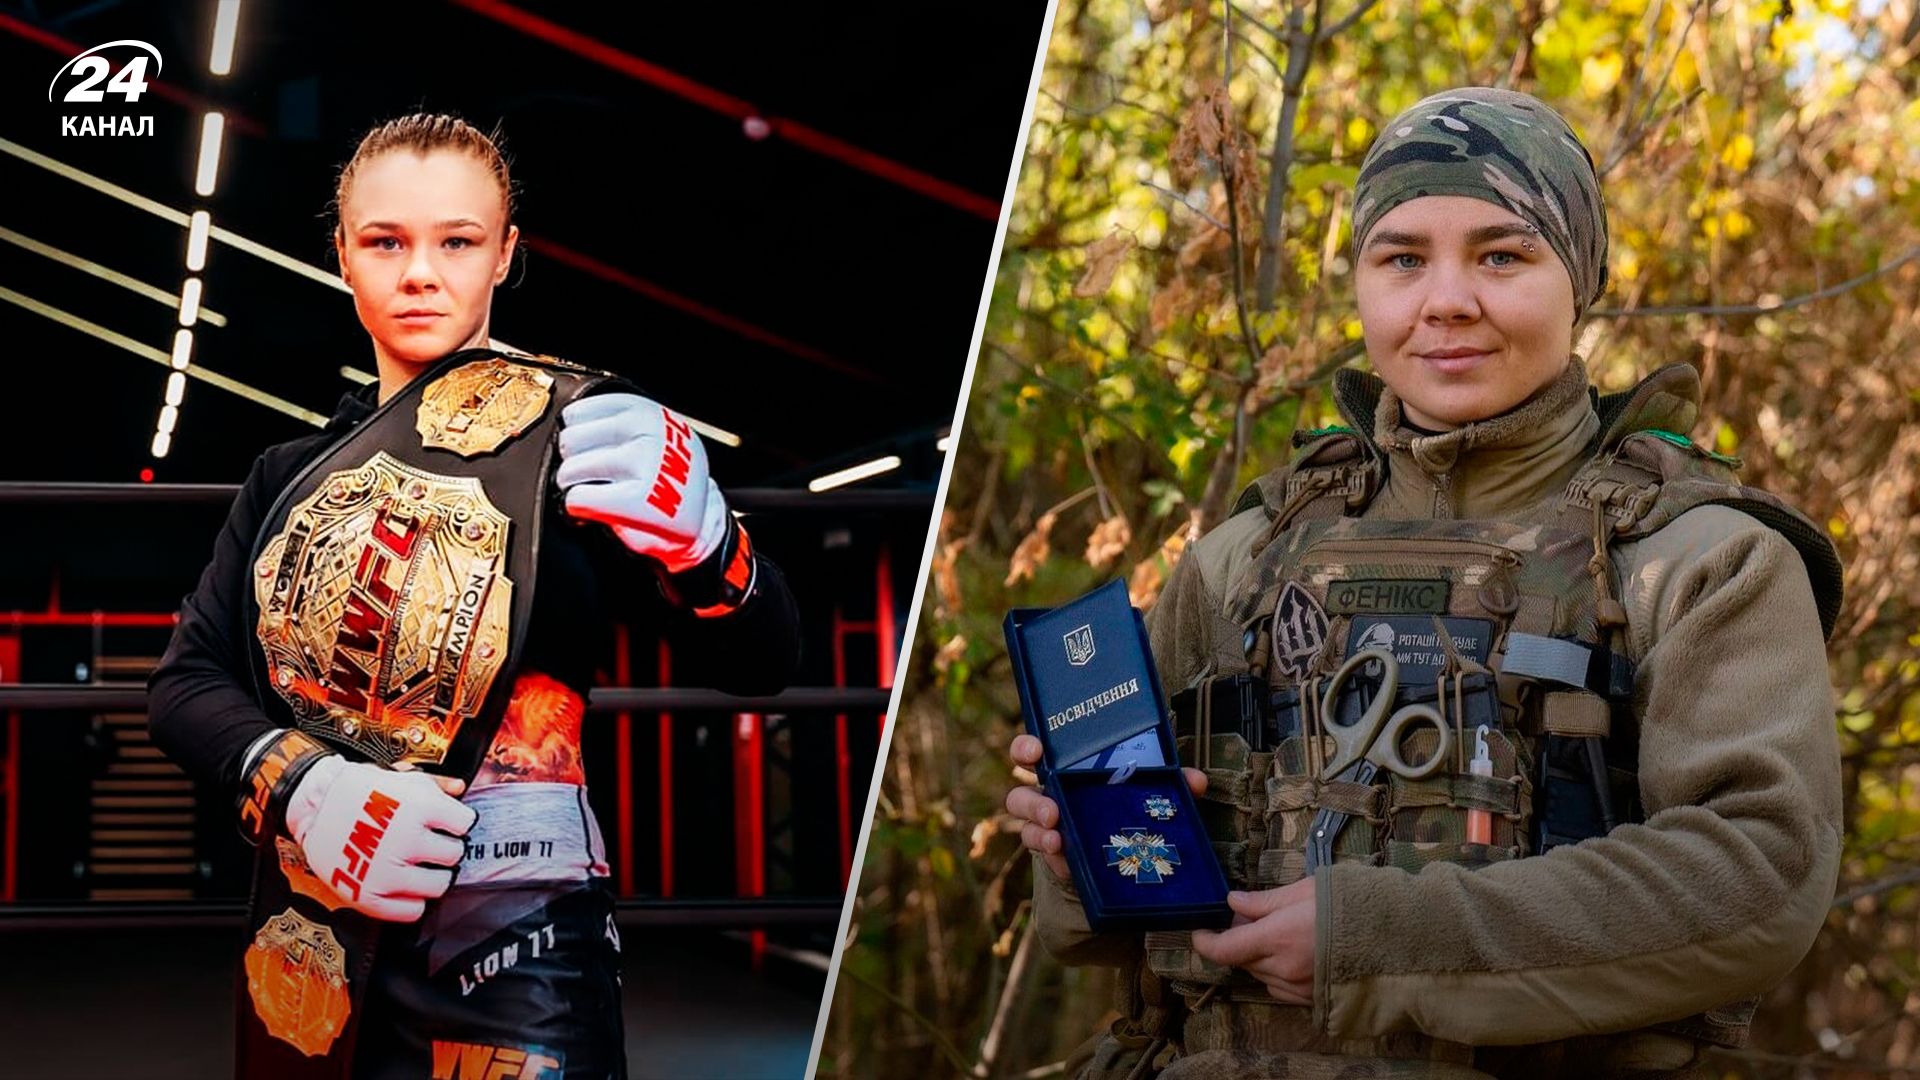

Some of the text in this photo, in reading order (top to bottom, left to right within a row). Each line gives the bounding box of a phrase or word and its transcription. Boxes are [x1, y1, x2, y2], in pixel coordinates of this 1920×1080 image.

[647, 407, 694, 518] WWFC
[327, 497, 421, 718] WWFC
[1338, 585, 1436, 609] ФЕНІКС
[436, 573, 486, 704] CHAMPION
[1397, 652, 1412, 664] МИ
[1414, 652, 1429, 665] ТУТ
[1047, 678, 1139, 732] ПОСВІДЧЕННЯ
[241, 731, 314, 834] WWFC
[331, 790, 400, 902] WWFC
[494, 841, 530, 858] LION
[459, 942, 519, 996] LION
